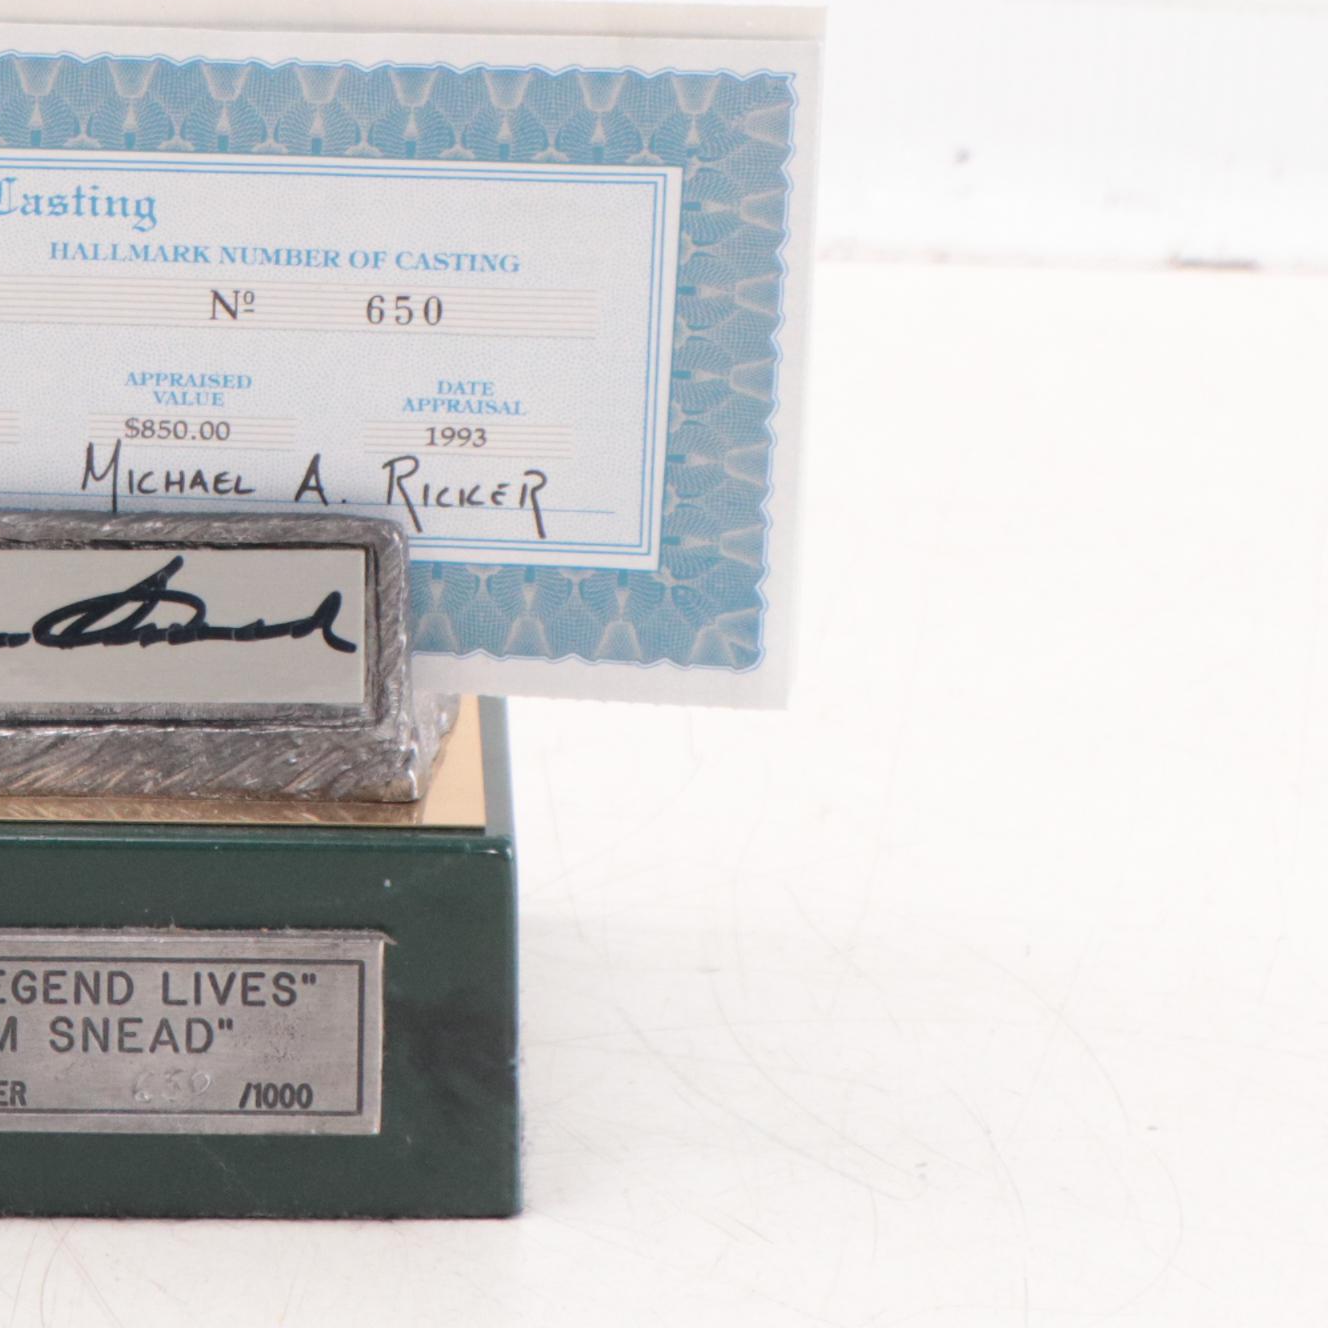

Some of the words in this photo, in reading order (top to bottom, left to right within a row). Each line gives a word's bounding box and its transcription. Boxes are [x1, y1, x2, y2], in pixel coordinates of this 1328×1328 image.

[50, 242, 210, 265] HALLMARK
[218, 246, 340, 268] NUMBER
[349, 249, 386, 269] OF
[395, 251, 520, 273] CASTING
[125, 371, 252, 389] APPRAISED
[437, 379, 494, 396] DATE
[153, 391, 223, 406] VALUE
[402, 396, 526, 416] APPRAISAL
[124, 417, 231, 443] $850.00
[425, 427, 487, 448] 1993
[295, 454, 347, 505] A.
[161, 972, 316, 1007] LIVES"
[49, 1017, 233, 1054] SNEAD"
[240, 1083, 313, 1109] /1000
